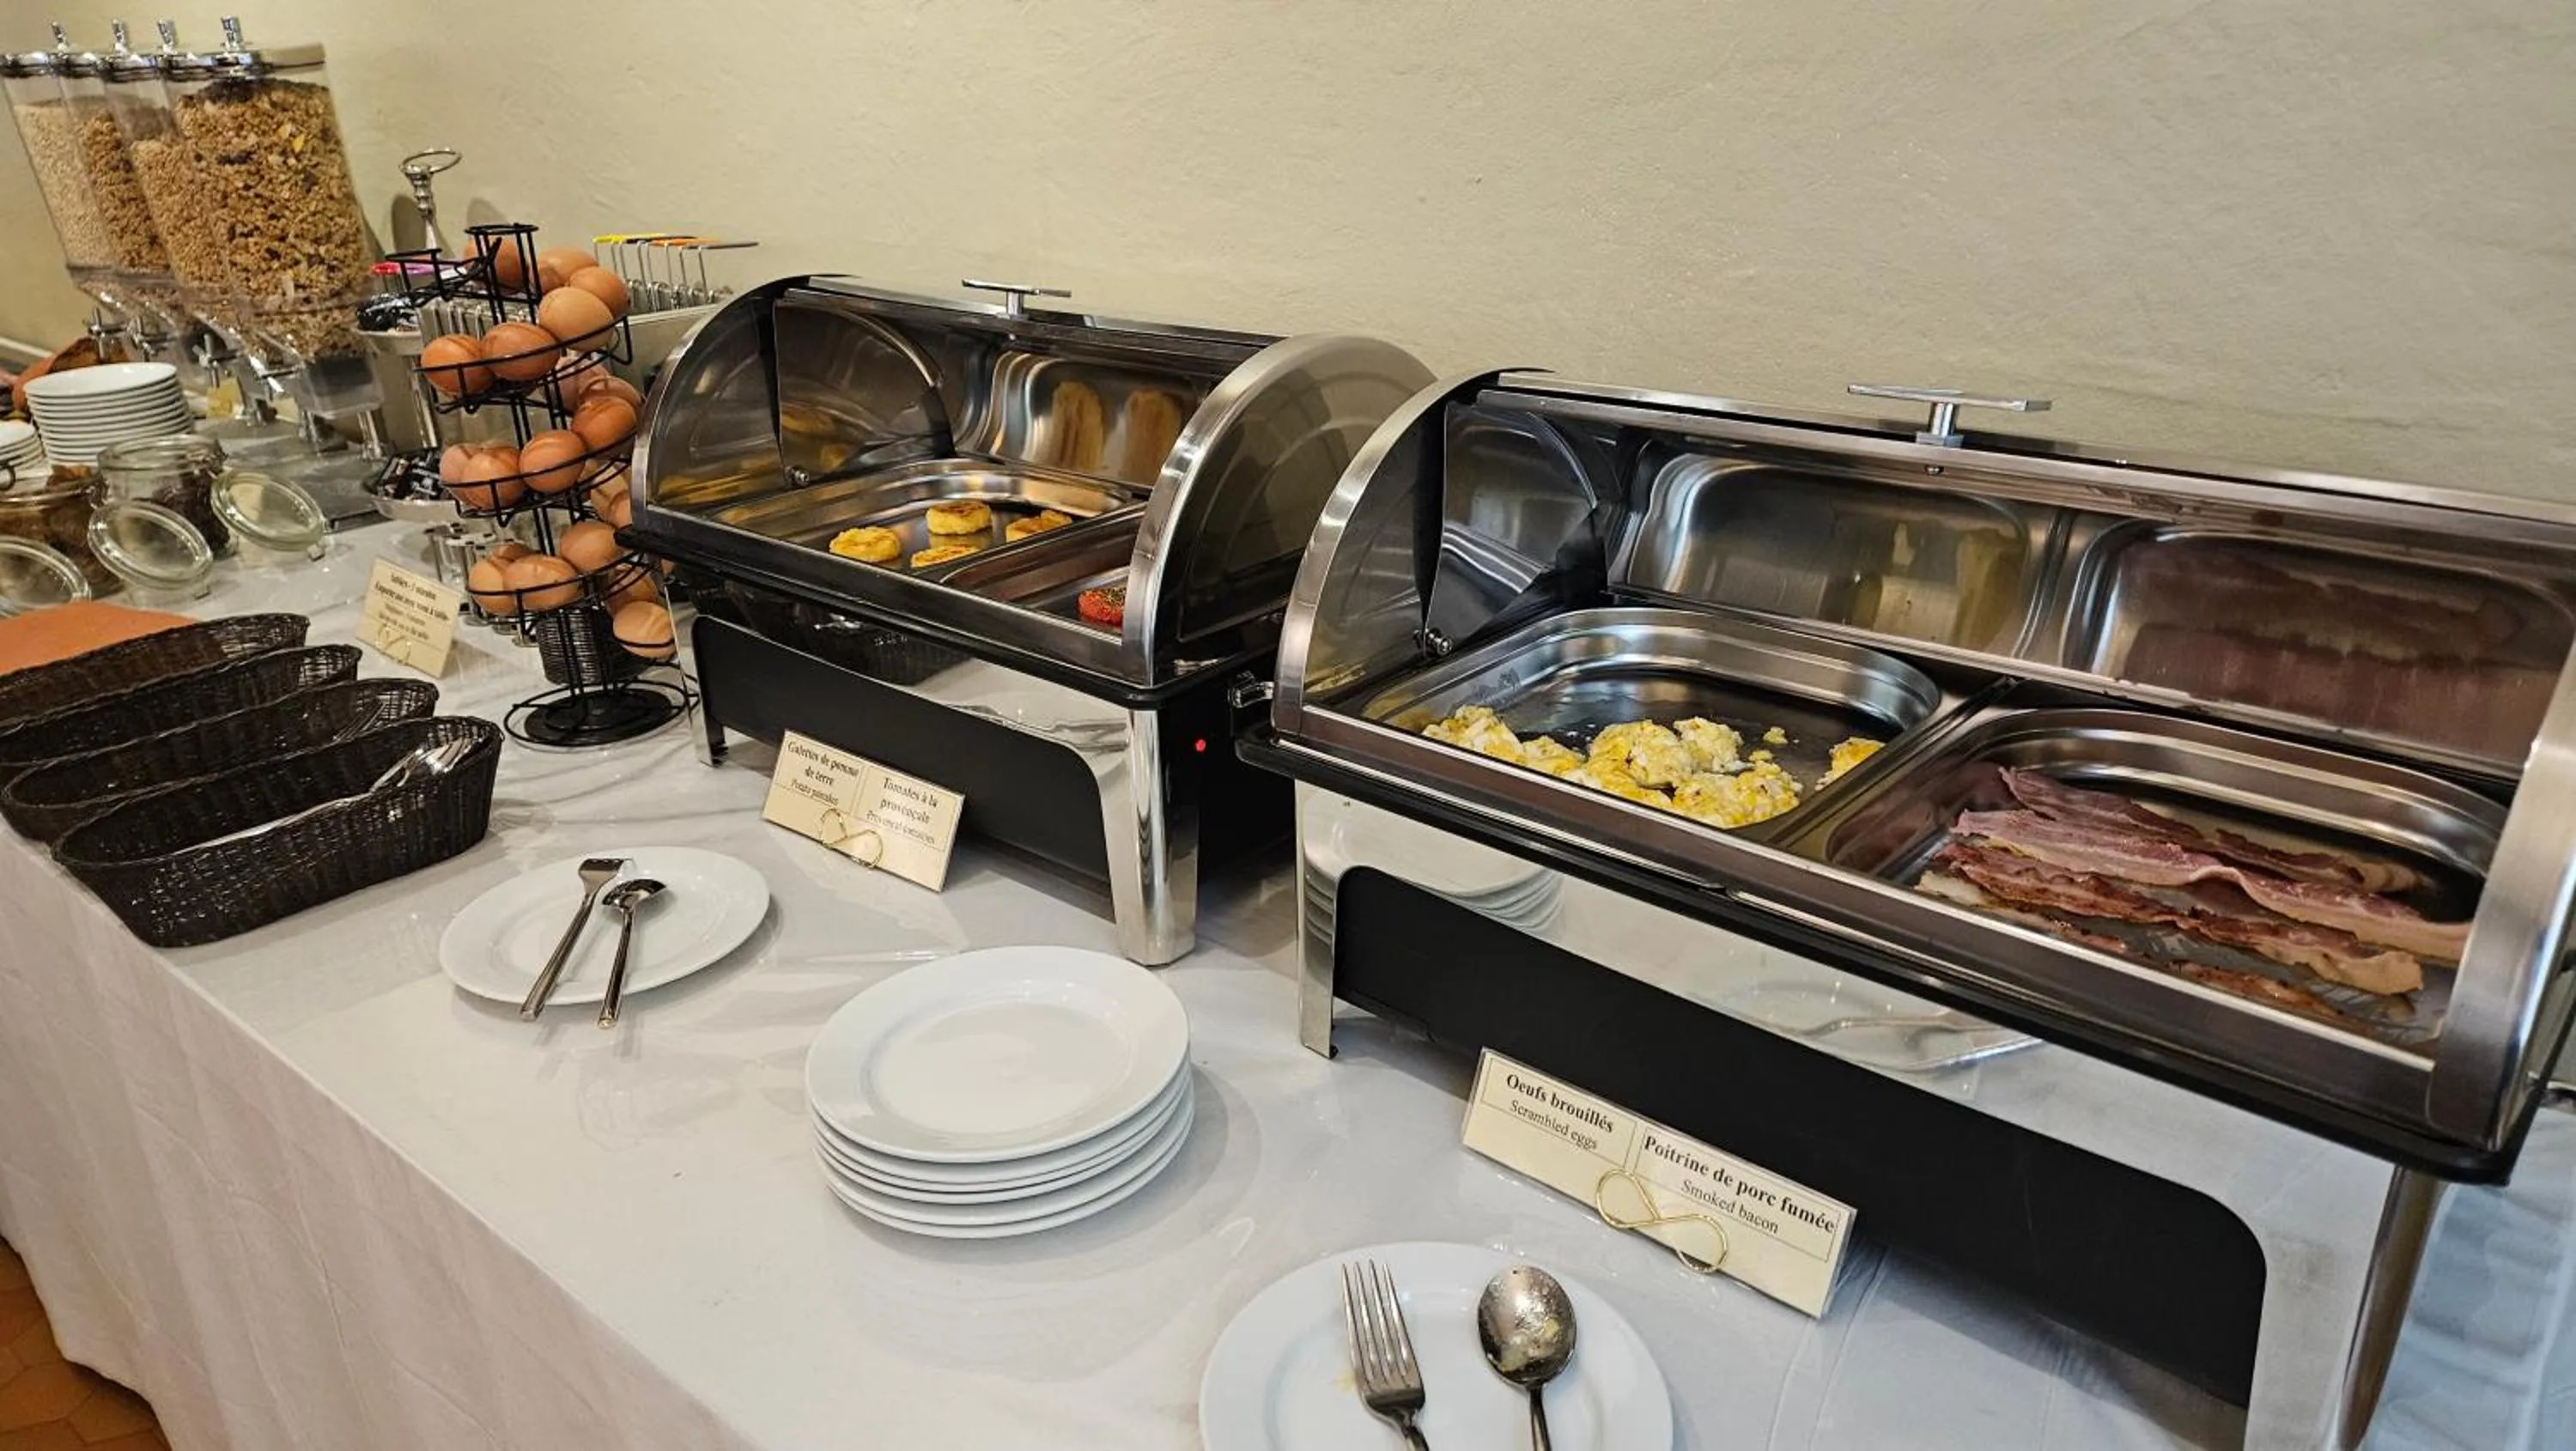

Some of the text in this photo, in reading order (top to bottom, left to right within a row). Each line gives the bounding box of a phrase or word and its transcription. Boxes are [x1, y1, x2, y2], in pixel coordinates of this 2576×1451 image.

[1507, 1073, 1614, 1133] Oeufs brouillés
[1510, 1100, 1598, 1150] Scrambled eggs
[1644, 1135, 1836, 1234] Poitrine de porc fumée
[1681, 1179, 1779, 1234] Smoked bacon
